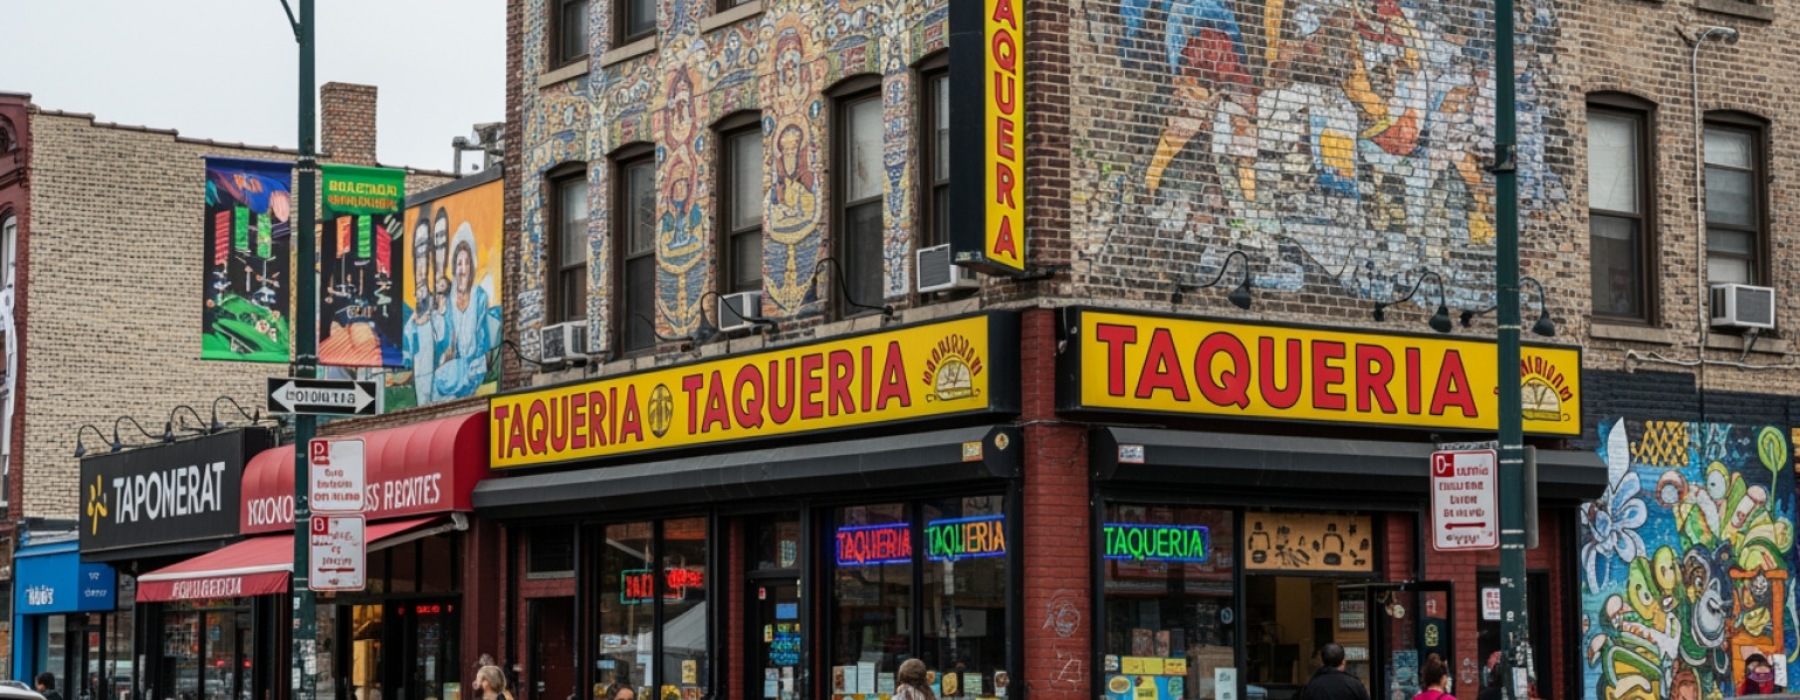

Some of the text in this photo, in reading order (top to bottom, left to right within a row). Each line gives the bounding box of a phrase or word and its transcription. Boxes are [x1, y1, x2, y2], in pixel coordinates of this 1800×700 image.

[494, 384, 644, 459] TAQUERIA
[682, 340, 912, 435] TAQUERIA
[1097, 322, 1479, 418] TAQUERIA
[113, 461, 226, 524] TAPOMERAT
[1104, 526, 1203, 560] TAQUERIA
